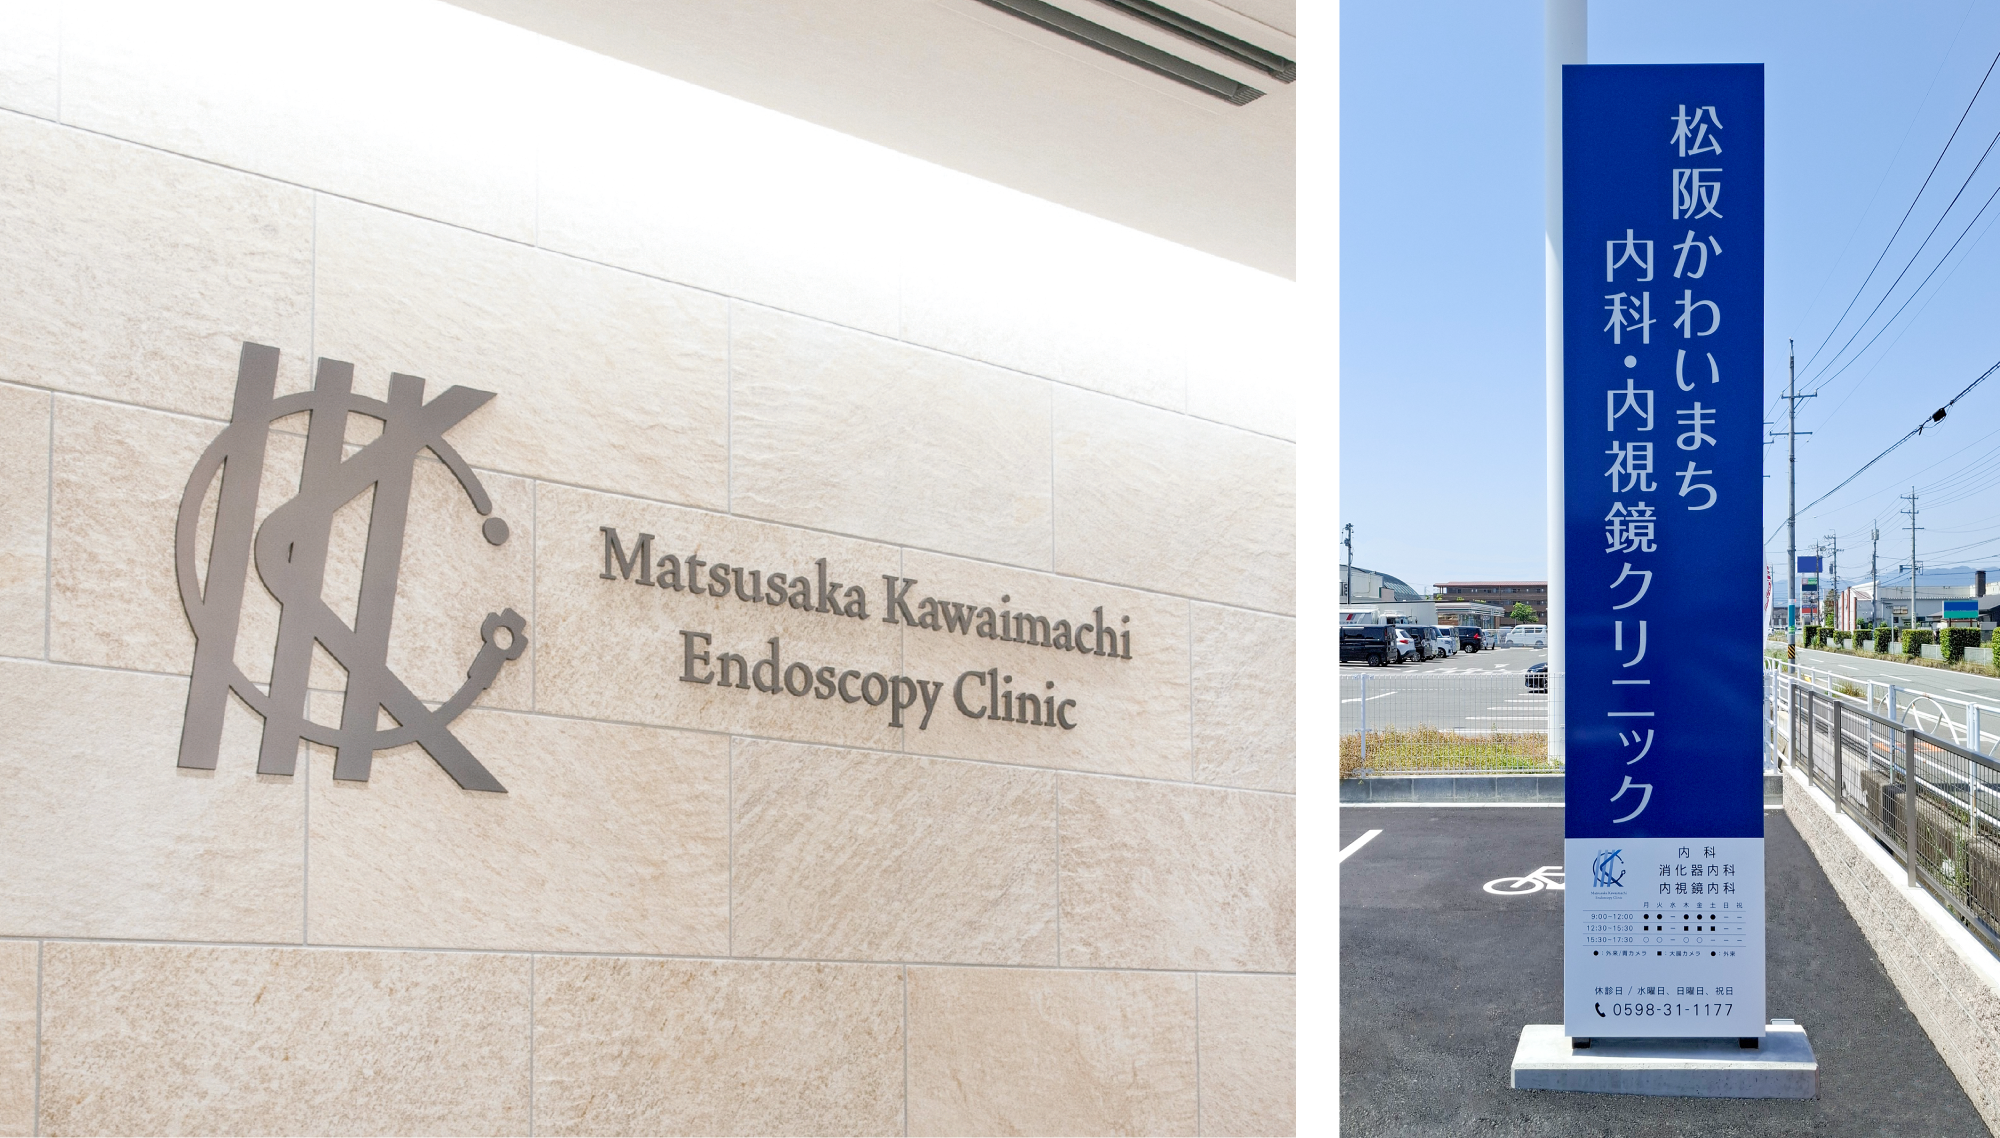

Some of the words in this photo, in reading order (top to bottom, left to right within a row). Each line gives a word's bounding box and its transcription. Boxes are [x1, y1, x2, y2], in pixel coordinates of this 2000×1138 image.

[1669, 104, 1724, 511] 松阪かわいまち
[1603, 228, 1658, 824] 内科・内視鏡クリニック
[599, 526, 870, 621] Matsusaka
[882, 574, 1133, 660] Kawaimachi
[679, 629, 944, 731] Endoscopy
[953, 667, 1077, 731] Clinic
[1659, 864, 1735, 877] 消化器内科
[1659, 882, 1735, 895] 内視鏡内科
[1594, 986, 1623, 996] 休診日
[1612, 1003, 1733, 1017] 0598-31-1177
